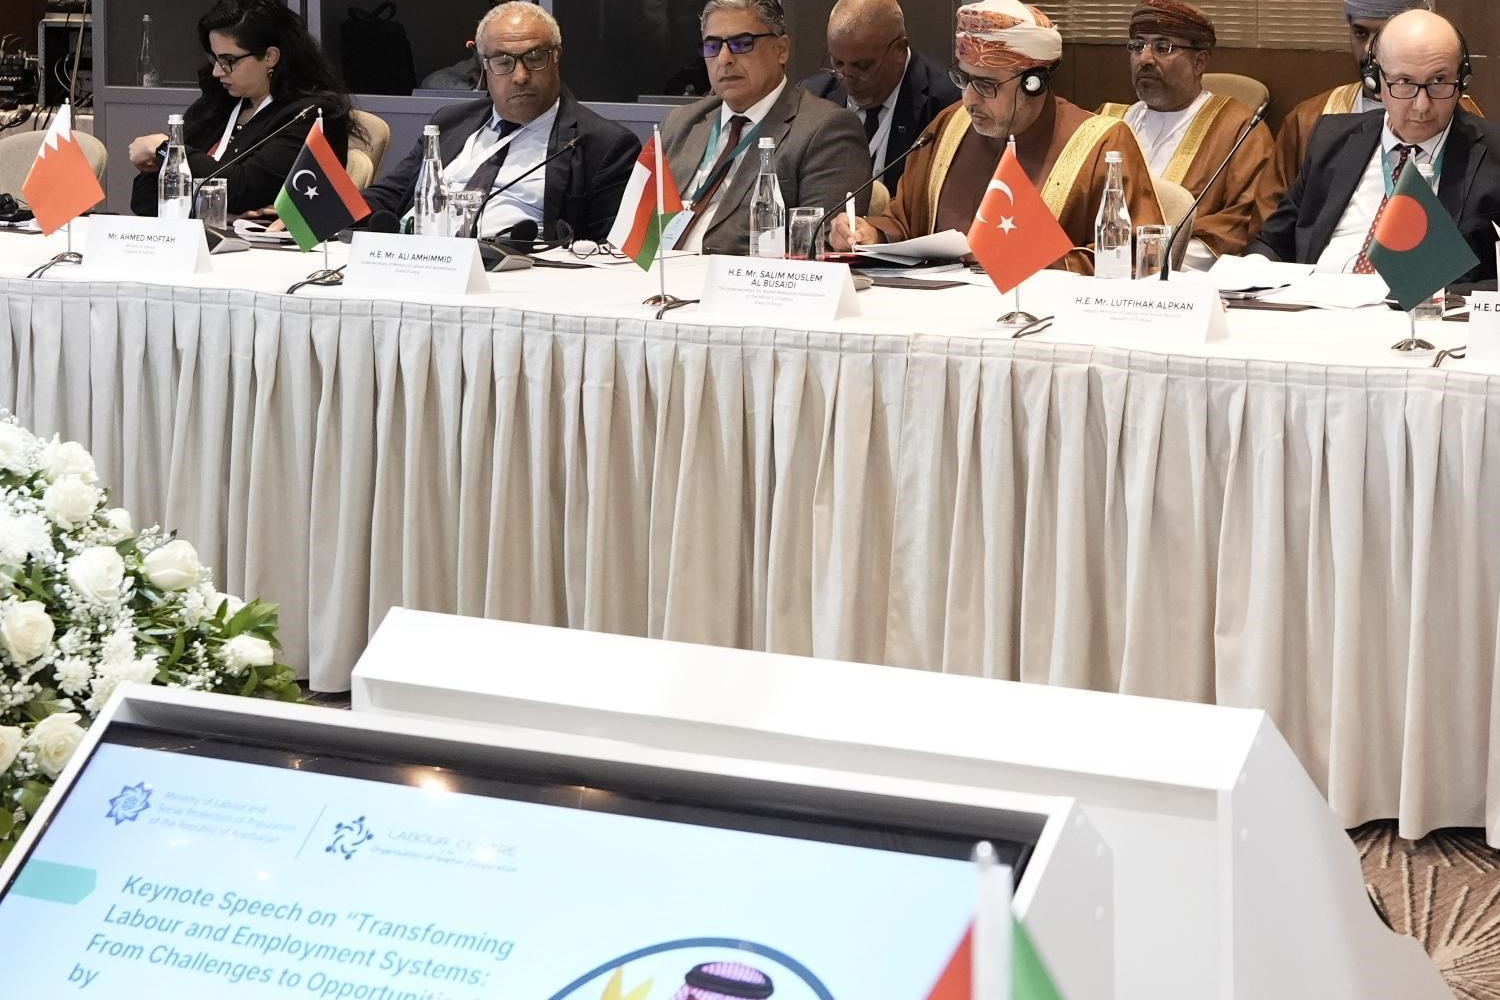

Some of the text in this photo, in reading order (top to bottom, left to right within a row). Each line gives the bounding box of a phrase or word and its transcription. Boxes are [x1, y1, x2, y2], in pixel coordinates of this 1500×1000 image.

[108, 232, 176, 243] Mr. AHMED MOFTAH
[370, 250, 452, 263] H.E. Mr. ALI AMHIMMID
[728, 268, 823, 282] H.E. Mr. SALIM MUSLEM
[751, 279, 796, 289] AL BUSAIDI
[1075, 297, 1194, 311] H.E. Mr. LUTFIHAK ALPKAN
[1474, 303, 1492, 312] H.E.
[121, 874, 214, 907] Keynote
[218, 891, 303, 922] Speech
[307, 909, 337, 927] on
[103, 904, 491, 987] Labour and Employment Systems:
[86, 933, 144, 960] From
[148, 944, 273, 984] Challenges
[278, 968, 301, 988] to
[67, 962, 99, 989] by
